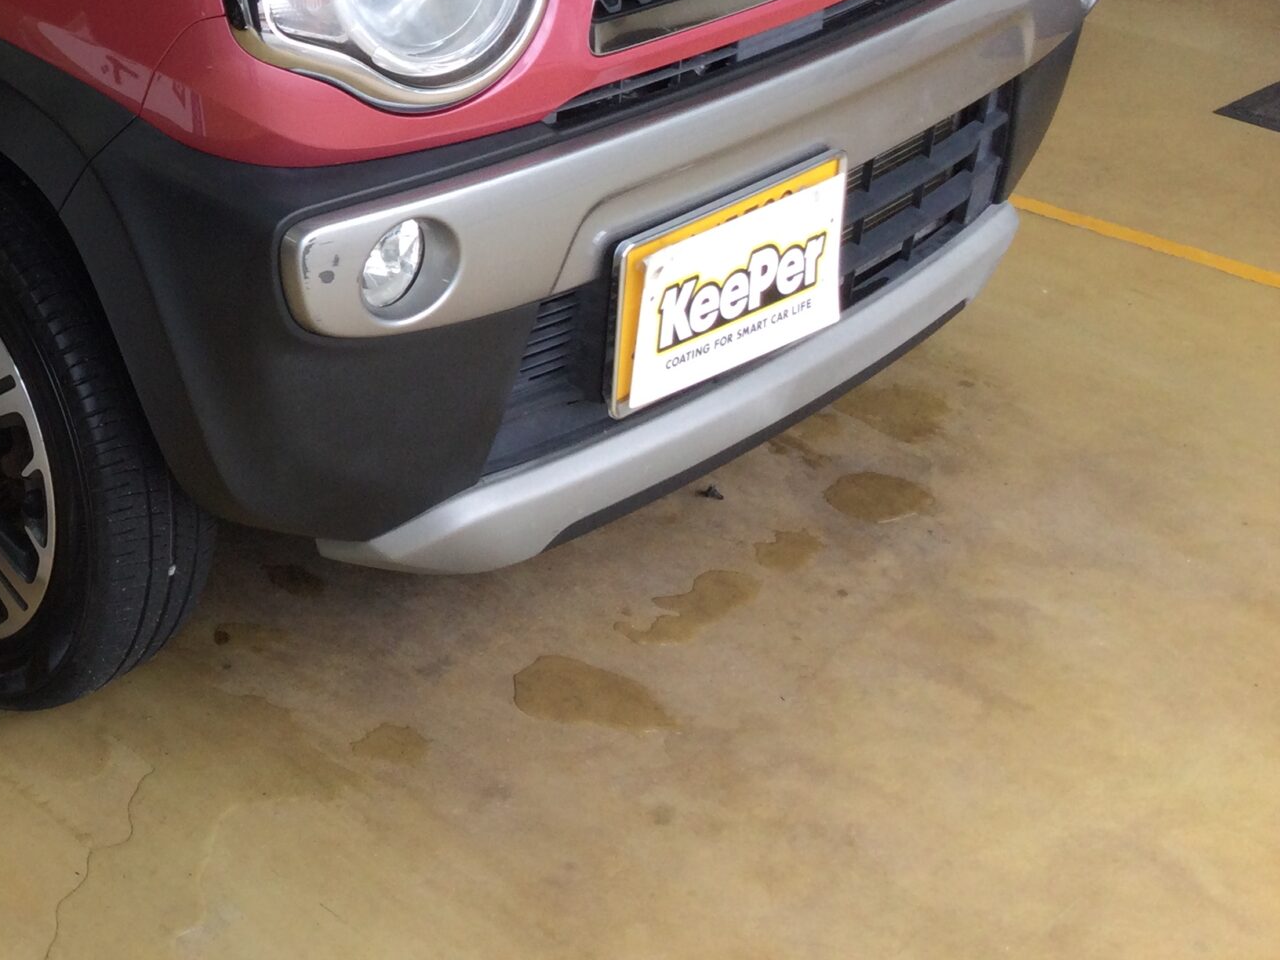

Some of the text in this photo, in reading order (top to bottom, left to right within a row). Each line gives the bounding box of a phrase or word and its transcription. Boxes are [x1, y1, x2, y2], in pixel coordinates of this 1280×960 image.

[657, 231, 827, 353] KeePer
[665, 298, 813, 370] COATING FOR SMART CAR LIFE
